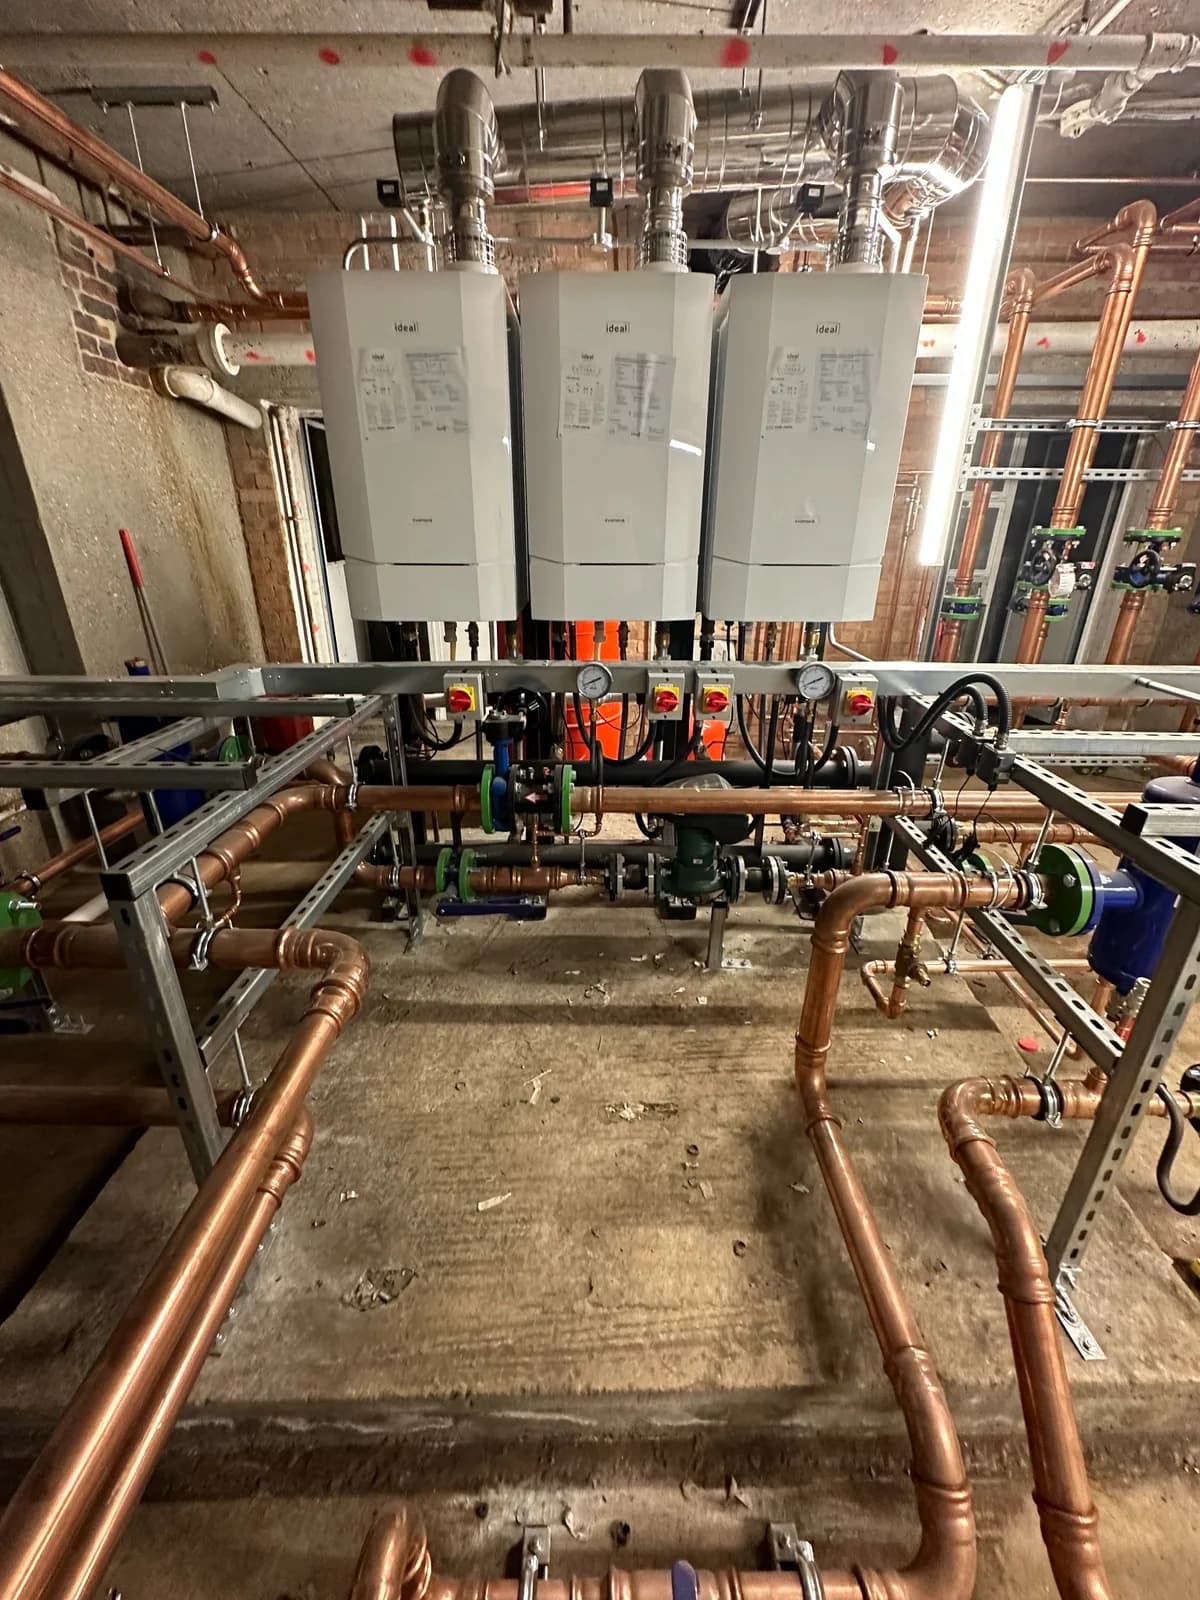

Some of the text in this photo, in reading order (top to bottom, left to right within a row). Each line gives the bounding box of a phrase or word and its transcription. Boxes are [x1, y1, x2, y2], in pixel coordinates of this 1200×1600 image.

[394, 322, 417, 333] ideal
[605, 322, 628, 334] ideal
[815, 323, 838, 335] ideal
